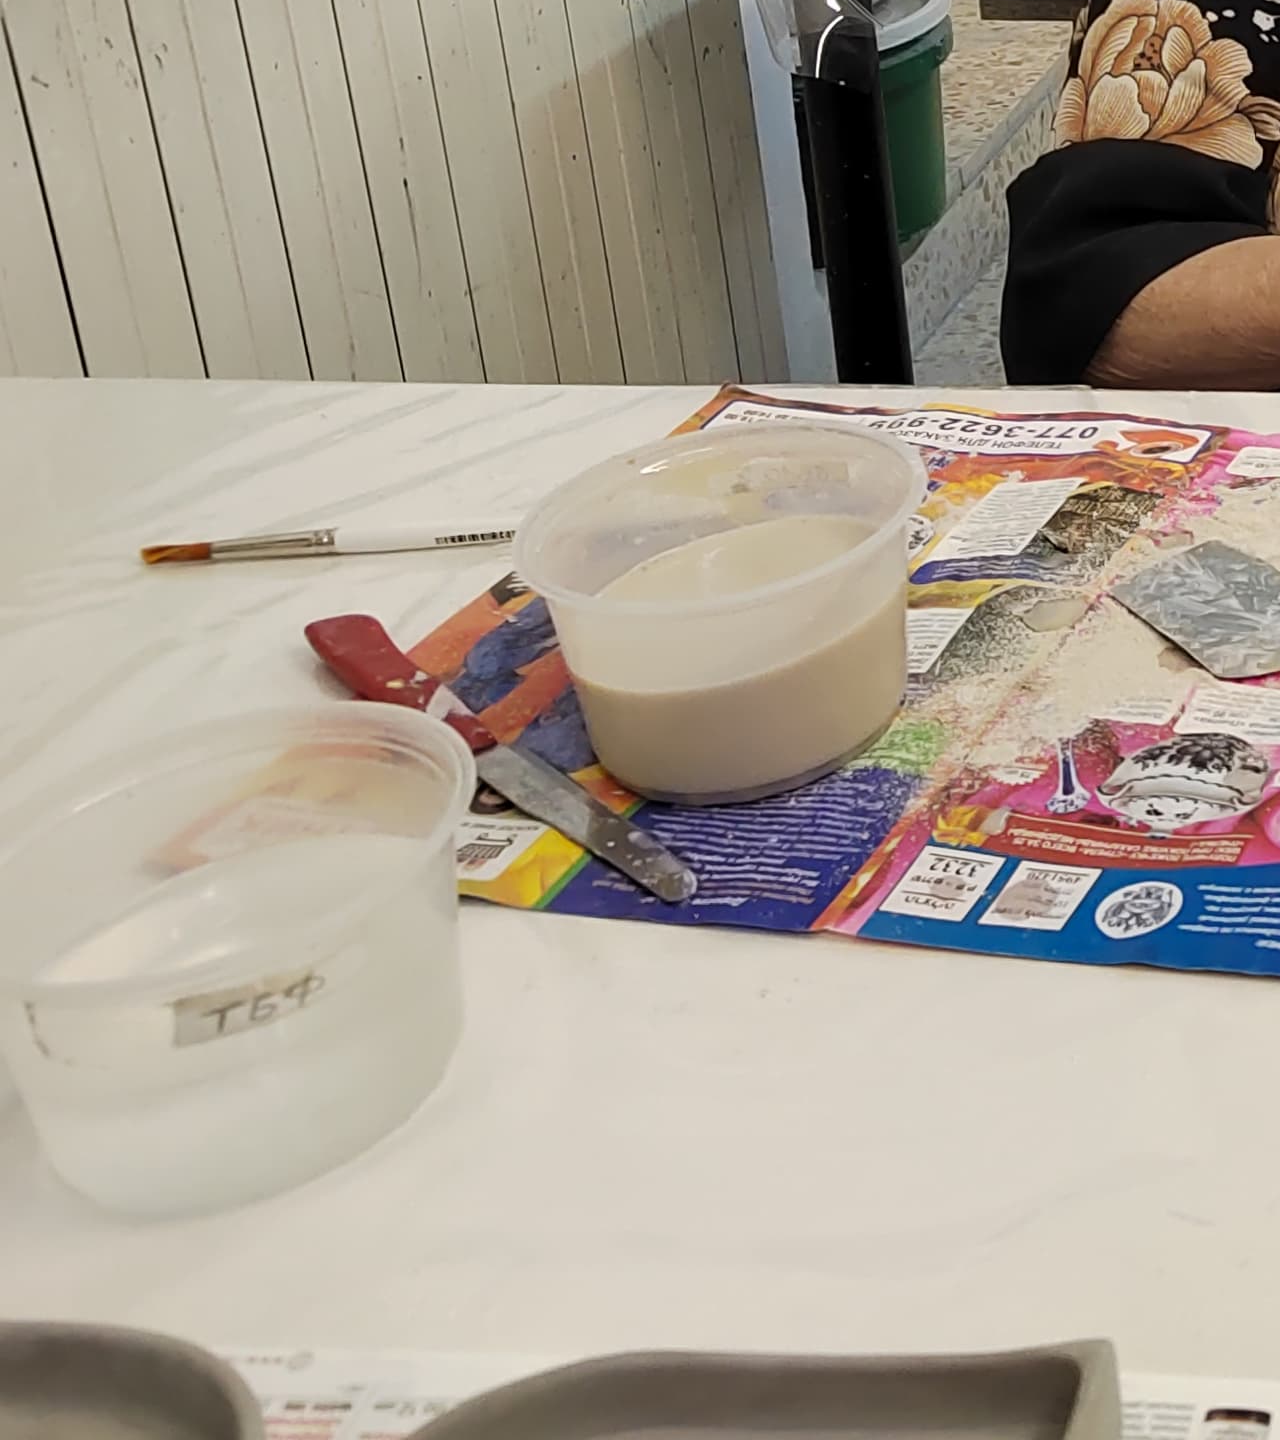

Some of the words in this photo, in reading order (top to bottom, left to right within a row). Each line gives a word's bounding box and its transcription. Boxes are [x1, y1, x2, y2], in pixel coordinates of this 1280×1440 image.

[868, 416, 1100, 440] 077-3622-999
[957, 436, 990, 447] ДЛЯ
[992, 440, 1062, 450] ТЕЛЕФОН
[928, 857, 985, 878] 3232
